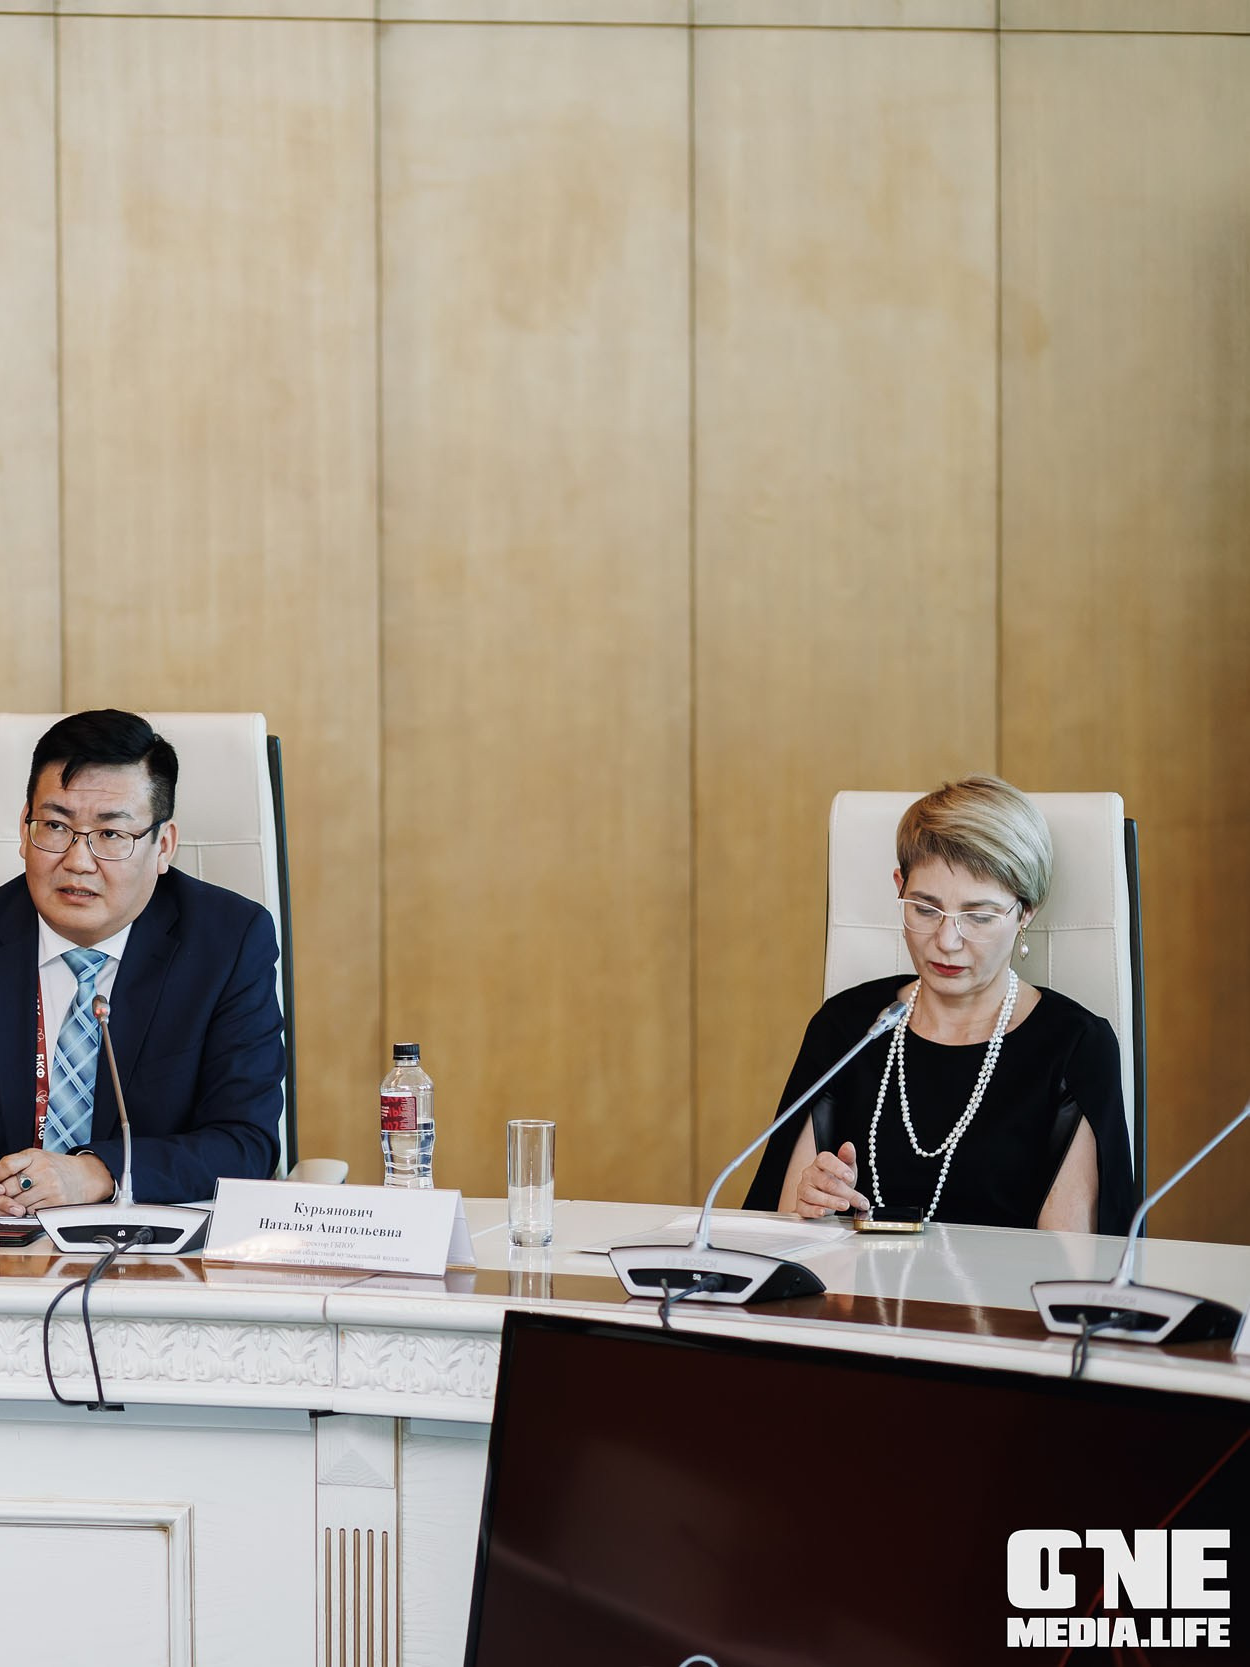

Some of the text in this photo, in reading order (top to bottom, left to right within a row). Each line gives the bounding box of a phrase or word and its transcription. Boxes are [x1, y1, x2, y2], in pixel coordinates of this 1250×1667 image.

[294, 1202, 374, 1218] Курьянович
[258, 1218, 402, 1238] Наталья Анатольевна
[681, 1257, 718, 1269] BOSCH
